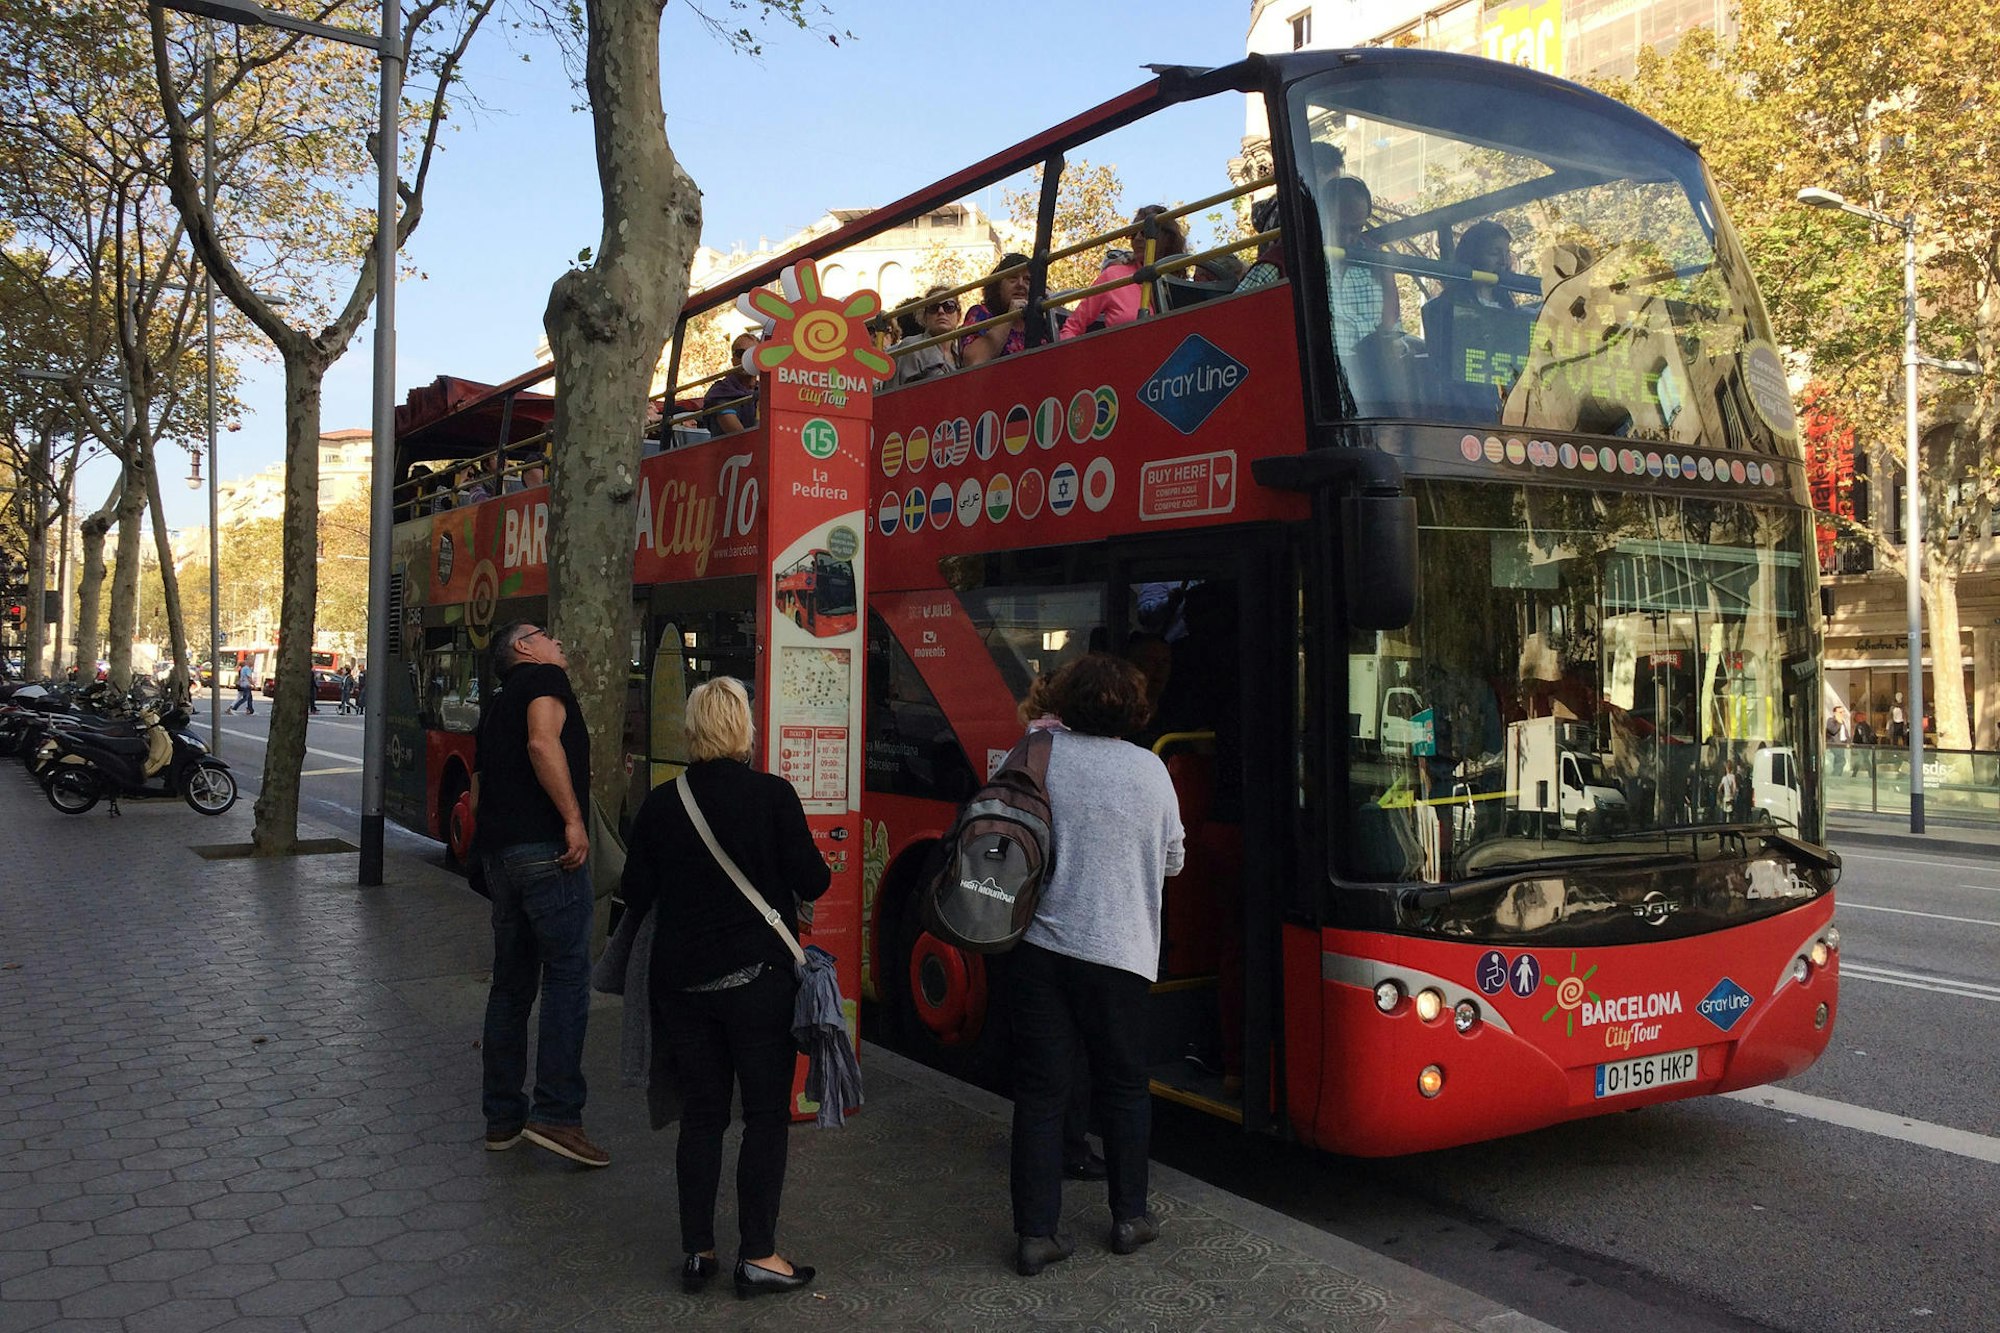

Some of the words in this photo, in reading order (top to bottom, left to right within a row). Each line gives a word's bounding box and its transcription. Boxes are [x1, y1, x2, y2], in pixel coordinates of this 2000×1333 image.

[778, 366, 867, 393] BARCELONA
[805, 427, 833, 453] 15
[813, 468, 828, 482] La
[1148, 467, 1172, 485] BUY
[1174, 463, 1207, 480] HERE
[792, 482, 848, 501] Pedrera
[960, 879, 977, 891] HIGH
[1581, 990, 1682, 1027] BARCELONA
[1701, 998, 1728, 1014] Gray
[1608, 1060, 1654, 1091] 0156
[1661, 1053, 1694, 1082] HKP
